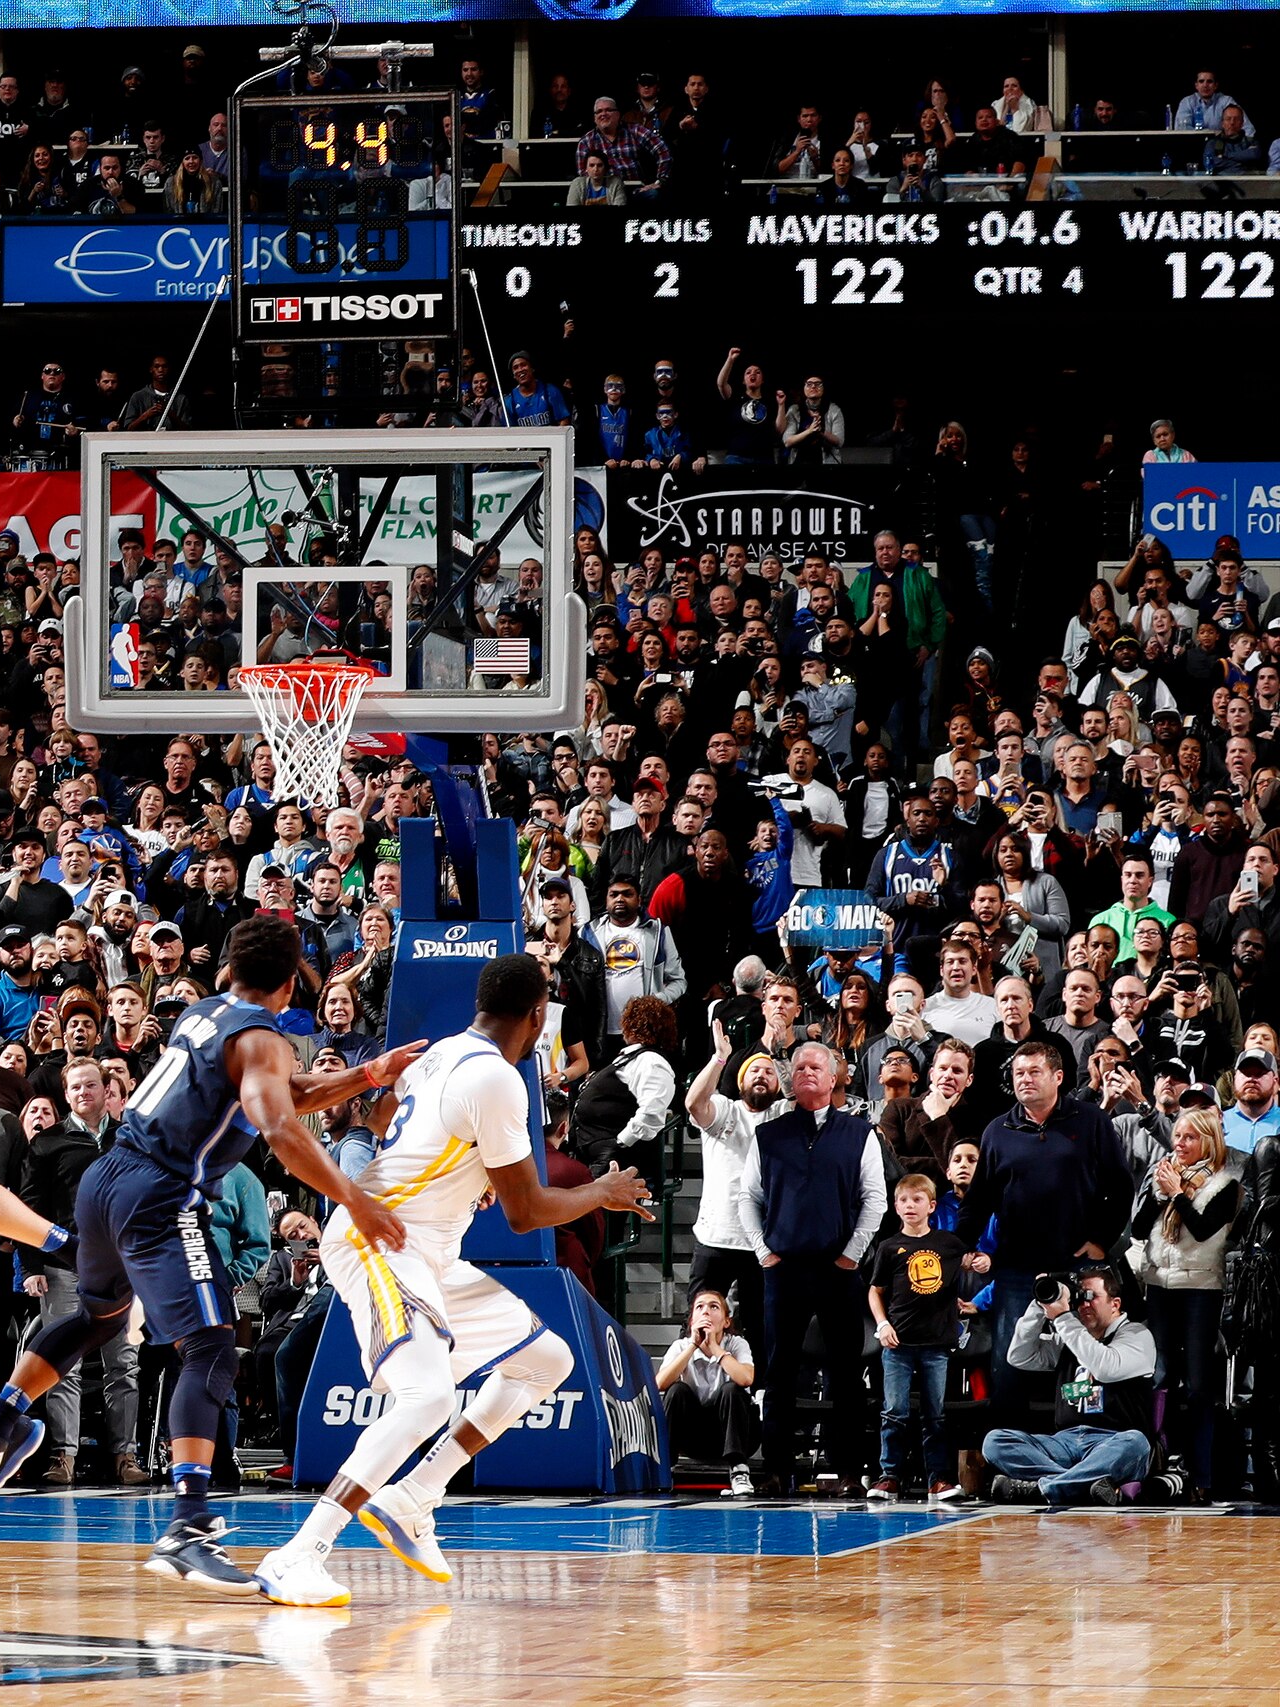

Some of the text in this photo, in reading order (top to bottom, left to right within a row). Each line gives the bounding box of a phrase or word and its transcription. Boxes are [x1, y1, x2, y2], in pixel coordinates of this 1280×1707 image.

[304, 121, 389, 171] 4.4
[460, 223, 583, 247] TIMEOUTS
[624, 219, 713, 243] FOULS
[747, 213, 939, 245] MAVERICKS
[968, 210, 1080, 246] :04.6
[505, 266, 532, 297] 0
[654, 262, 680, 297] 2
[795, 257, 906, 304] 122
[974, 266, 1084, 297] QTR 4
[1164, 251, 1275, 299] 122
[304, 294, 443, 321] TISSOT
[418, 492, 513, 517] CRT
[1150, 494, 1217, 532] citi
[380, 519, 482, 540] FLAVR
[697, 507, 862, 536] STARPOWER
[113, 674, 130, 685] NBA
[788, 905, 813, 932] GO
[412, 939, 498, 960] SPALDING
[618, 943, 635, 954] 30
[921, 1258, 935, 1269] 30
